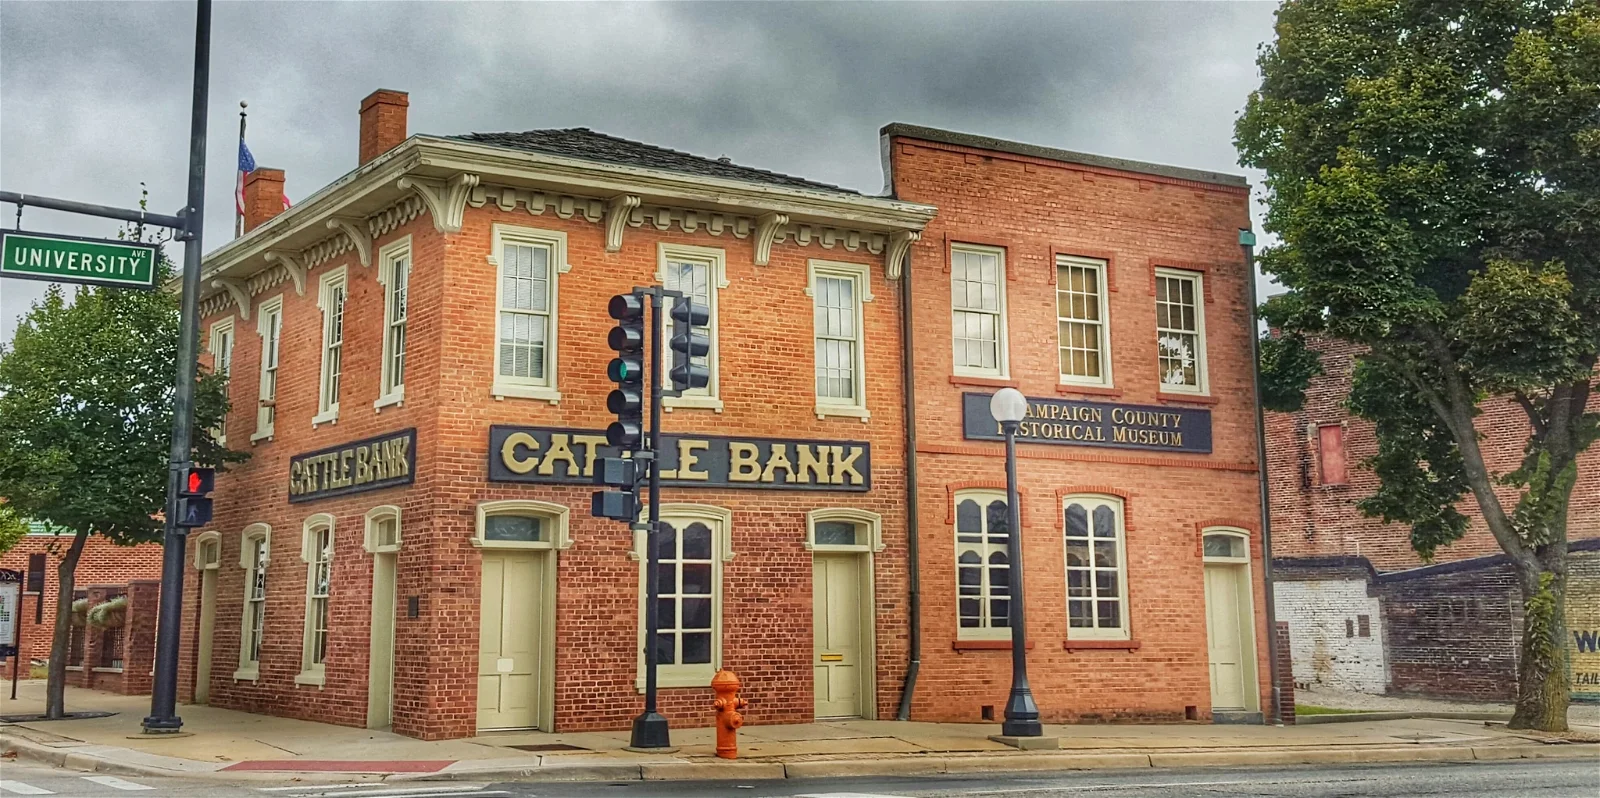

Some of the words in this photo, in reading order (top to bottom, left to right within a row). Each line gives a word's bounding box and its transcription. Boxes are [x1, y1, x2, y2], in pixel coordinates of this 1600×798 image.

[15, 247, 141, 276] UNIVERSITY
[131, 250, 147, 259] AVE
[1025, 403, 1102, 422] AMPAIGN
[290, 448, 354, 495] CATTLE
[354, 436, 410, 484] BANK
[501, 432, 709, 480] CATLE
[729, 441, 864, 485] BANK
[1573, 630, 1600, 653] W
